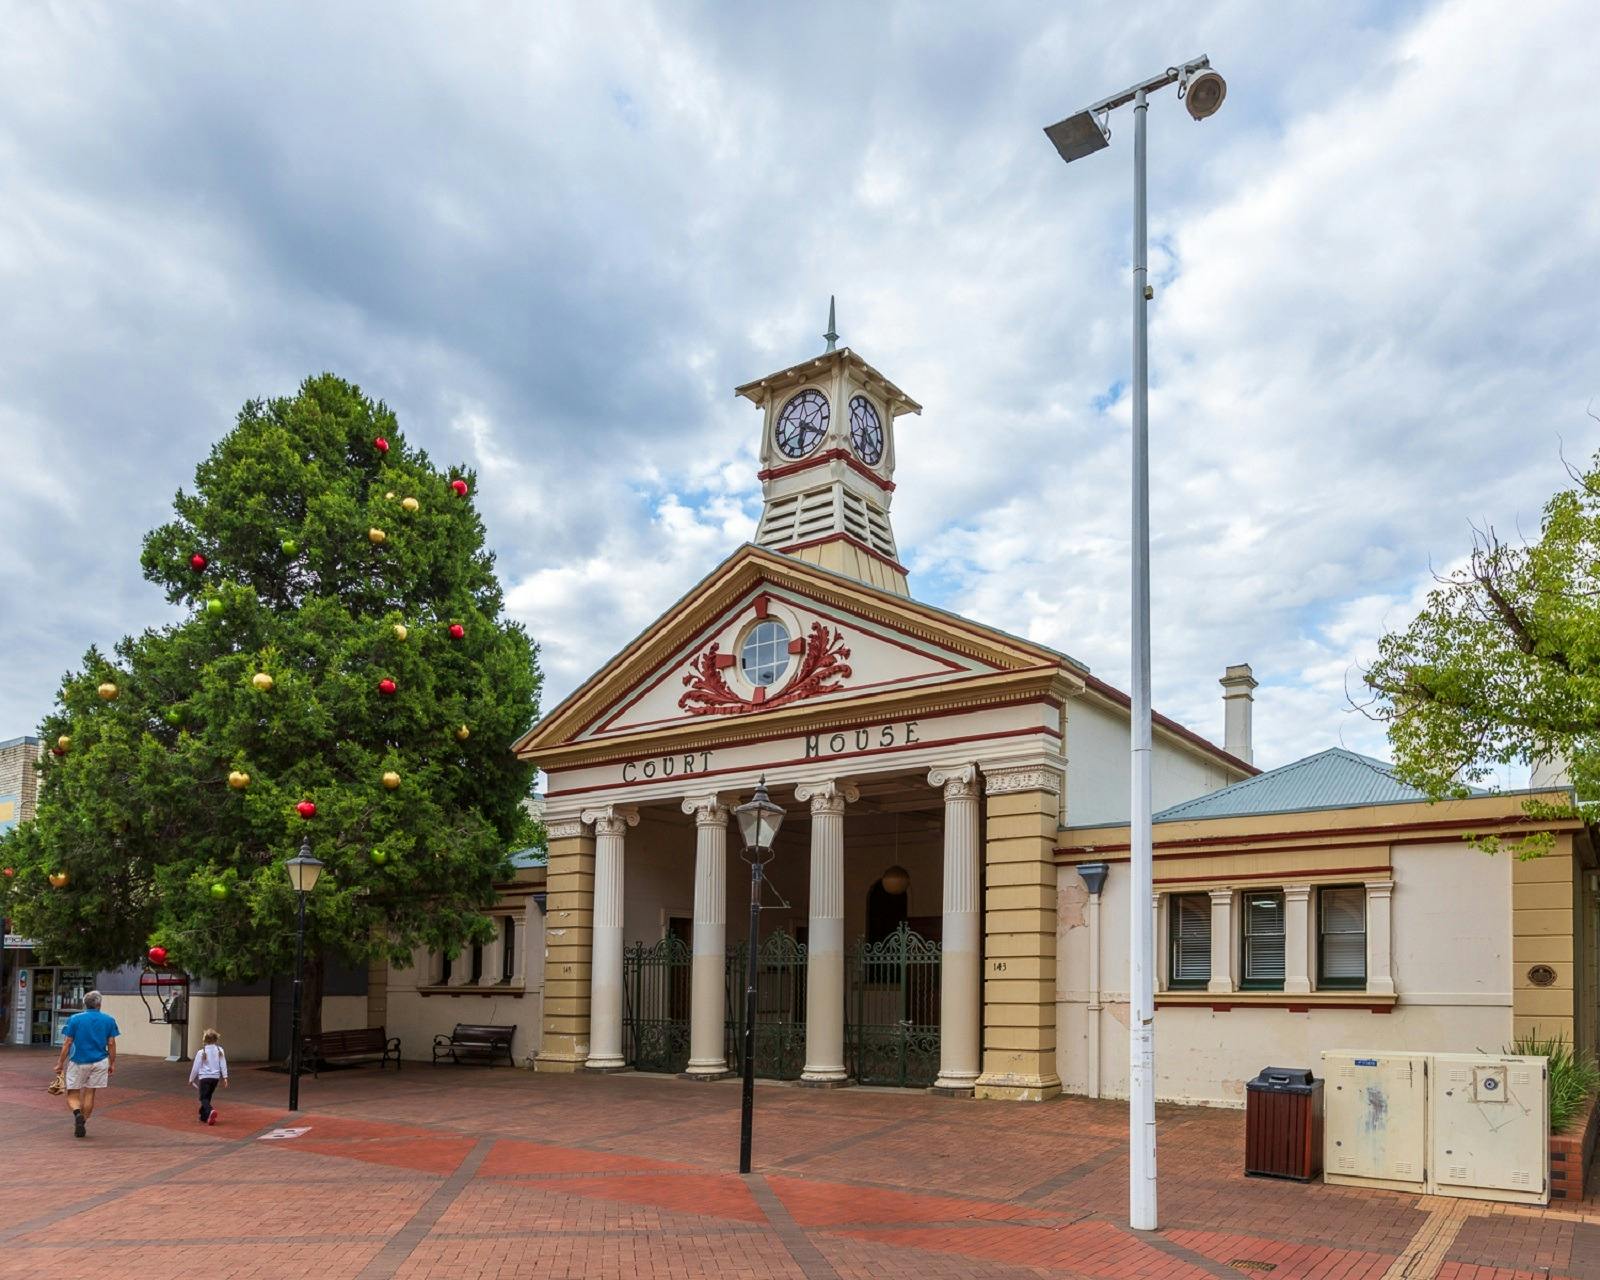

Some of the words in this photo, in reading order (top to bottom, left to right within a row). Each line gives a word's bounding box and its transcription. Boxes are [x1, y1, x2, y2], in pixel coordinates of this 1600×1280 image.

[622, 751, 714, 783] COURT
[804, 721, 921, 759] HOUSE
[993, 962, 1007, 972] 143
